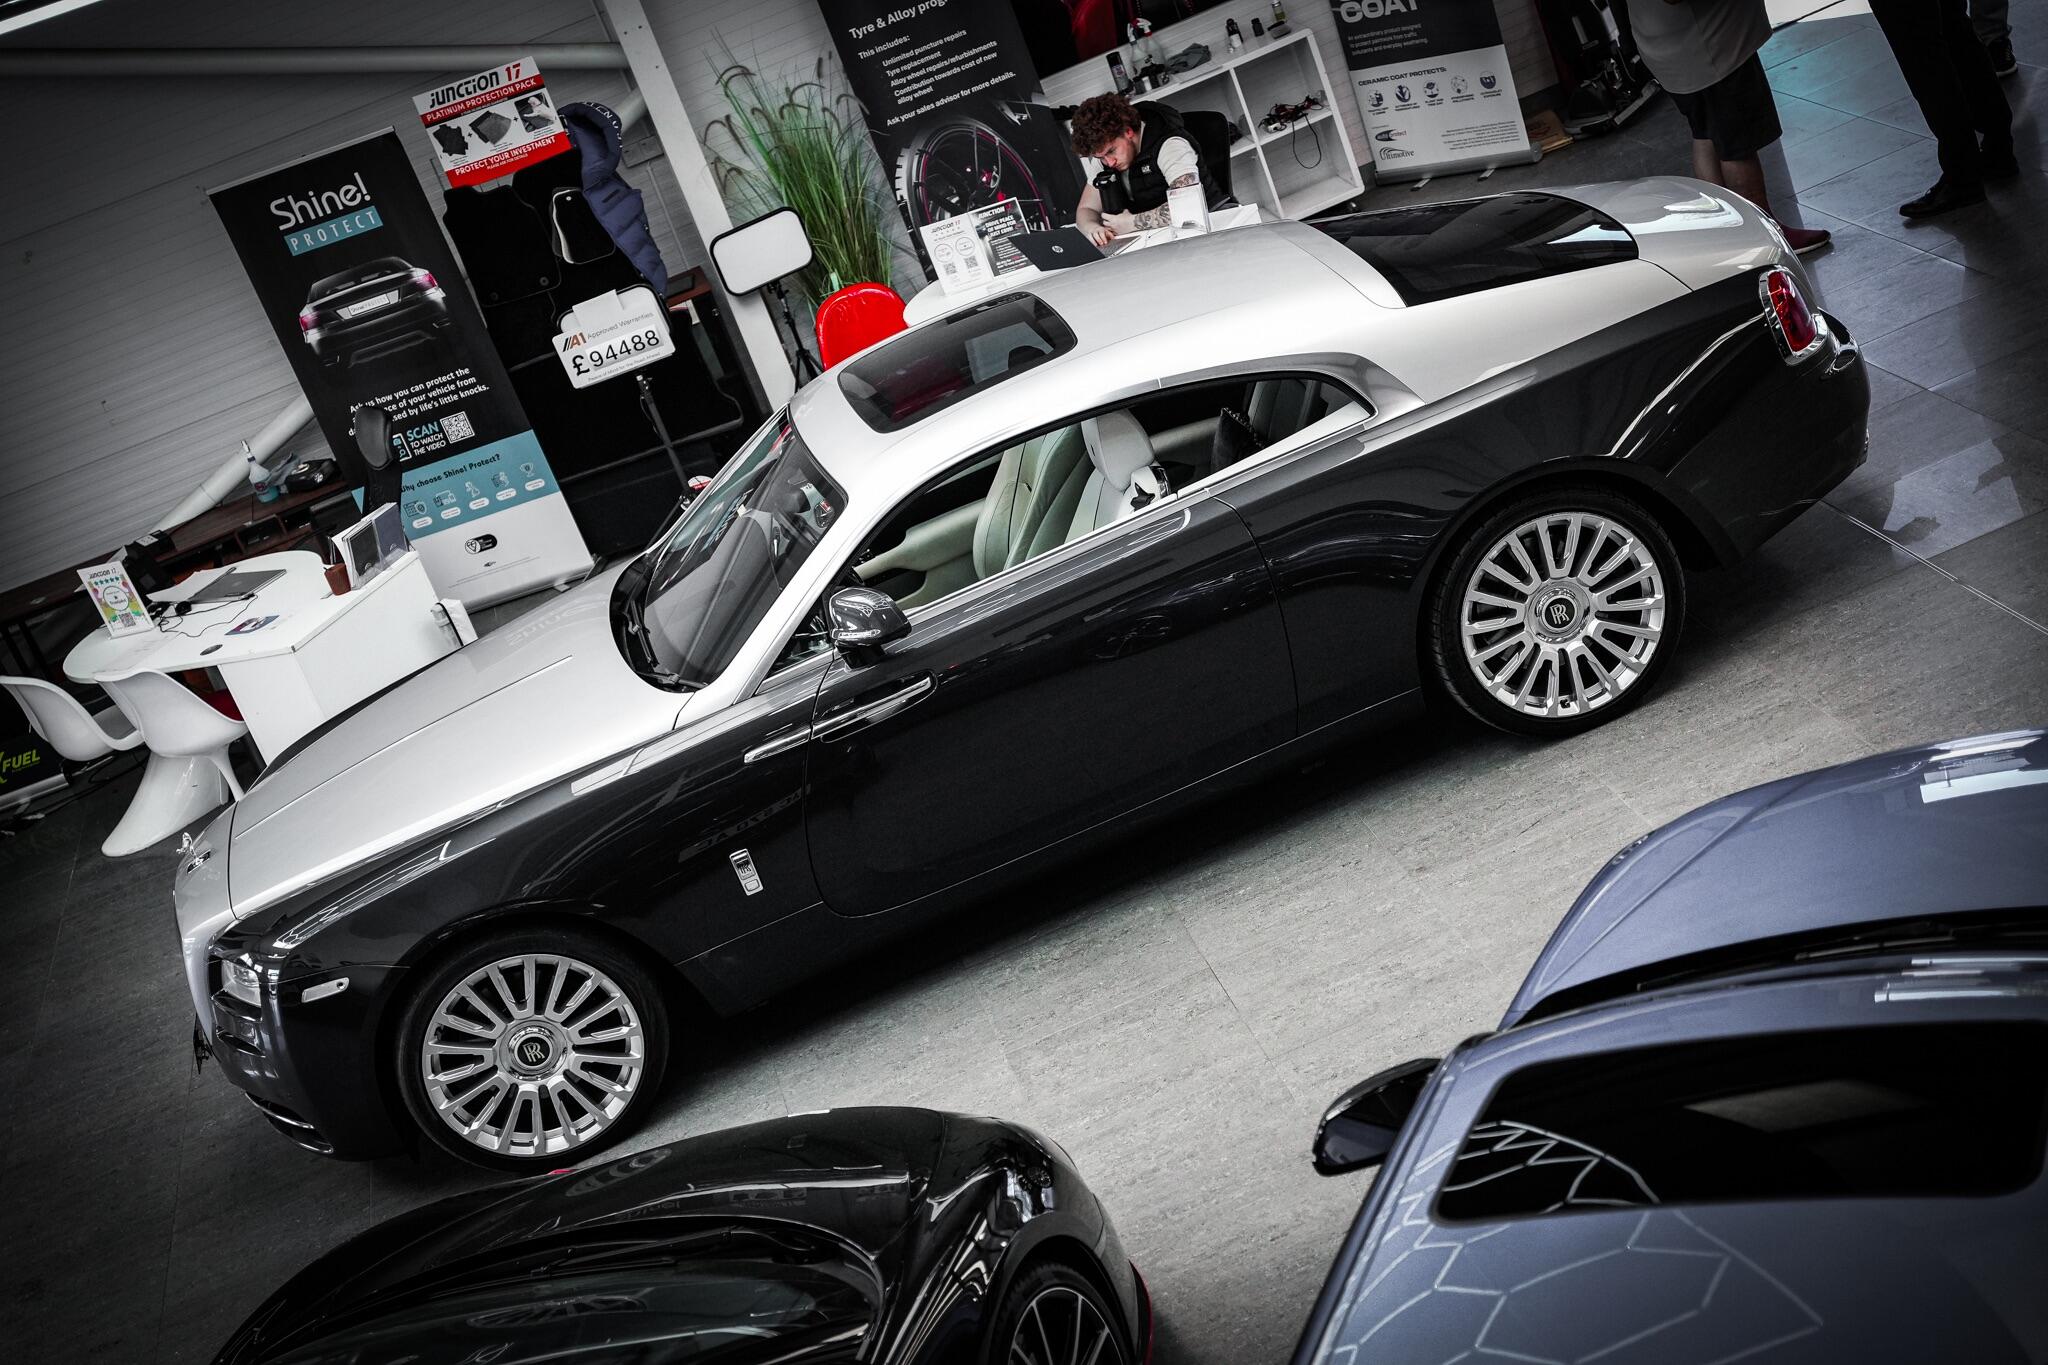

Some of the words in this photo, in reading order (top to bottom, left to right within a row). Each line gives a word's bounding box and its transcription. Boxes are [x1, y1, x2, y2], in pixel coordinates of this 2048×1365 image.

[849, 24, 875, 39] Tyre
[876, 18, 886, 28] &
[887, 7, 916, 25] Alloy
[918, 0, 947, 14] prog
[858, 48, 874, 59] This
[875, 35, 910, 52] includes:
[882, 50, 914, 66] Unlimited
[914, 38, 944, 54] puncture
[943, 29, 966, 42] repairs
[886, 67, 900, 77] Tyre
[900, 51, 941, 71] replacement
[890, 76, 906, 87] Alloy
[906, 68, 926, 79] wheel
[925, 40, 997, 72] repairs/refurbishments
[504, 63, 523, 80] 17
[894, 77, 934, 96] Contribution
[934, 66, 961, 80] towards
[960, 60, 975, 70] cost
[983, 52, 997, 60] new
[1358, 76, 1388, 85] CERAMIC
[1409, 66, 1446, 76] PROTECTS:
[426, 102, 464, 121] PLATINUM
[466, 85, 513, 107] PROTECTION
[515, 78, 535, 90] PACK
[886, 115, 900, 126] Ask
[900, 110, 915, 121] your
[916, 102, 934, 114] sales
[934, 92, 960, 106] advisor
[960, 88, 970, 96] for
[971, 81, 989, 92] more
[989, 70, 1015, 84] details.
[897, 94, 913, 104] alloy
[913, 86, 933, 97] wheel
[455, 159, 486, 175] PROTECT
[488, 152, 509, 164] YOUR
[510, 135, 555, 157] INVESTMENT
[270, 172, 370, 230] Shine!
[290, 211, 376, 251] PROTECT
[588, 323, 618, 339] Approved
[620, 312, 654, 327] Warranties
[572, 330, 659, 376] £94488
[375, 392, 392, 404] how
[394, 389, 408, 398] you
[410, 383, 424, 392] can
[425, 371, 454, 388] protect
[455, 366, 469, 376] the
[408, 394, 426, 405] your
[427, 382, 455, 398] vehicle
[456, 375, 475, 387] from
[408, 407, 418, 416] by
[439, 393, 458, 405] little
[459, 381, 488, 398] knocks.
[406, 422, 438, 440] SCAN
[410, 440, 419, 448] TO
[420, 432, 442, 444] WATCH
[414, 446, 425, 454] THE
[426, 440, 445, 450] VIDEO
[416, 473, 441, 487] choose
[443, 465, 466, 477] Shine!
[468, 453, 500, 469] Protect?
[2, 750, 40, 772] FUEL
